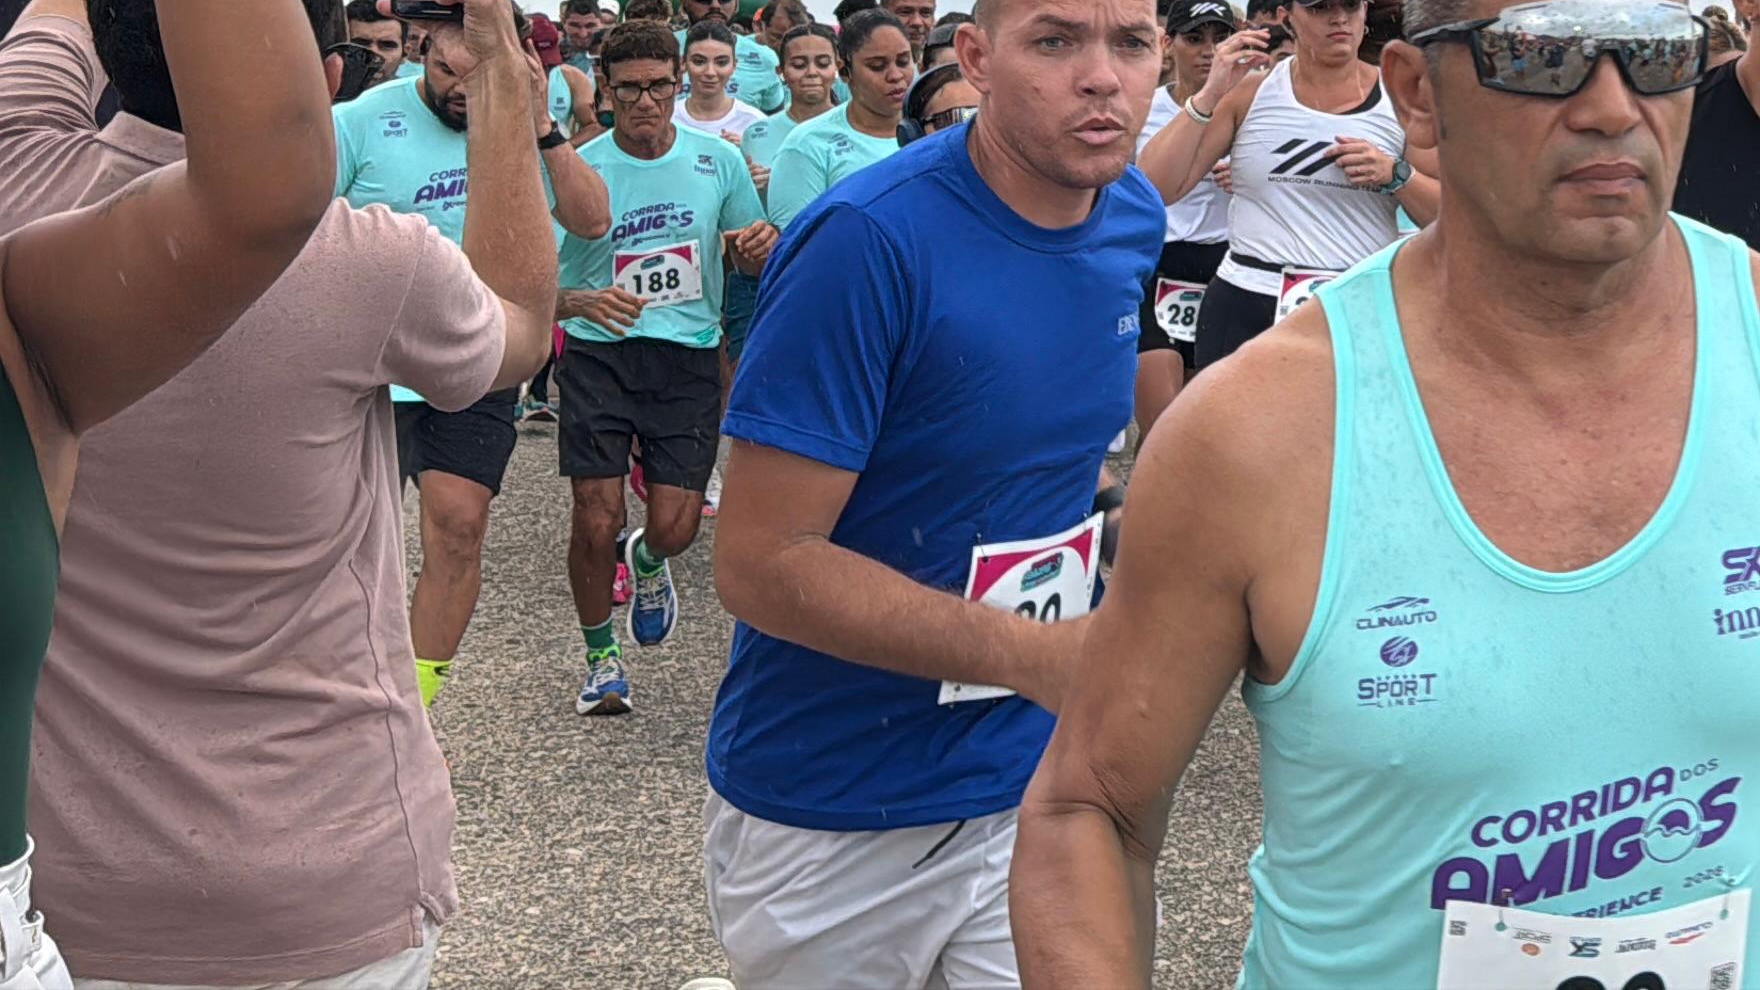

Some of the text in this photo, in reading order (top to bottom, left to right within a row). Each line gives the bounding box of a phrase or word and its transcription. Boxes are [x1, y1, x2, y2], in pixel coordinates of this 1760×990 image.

[429, 167, 467, 183] CORR
[1267, 176, 1312, 185] MOSCOW
[413, 178, 468, 204] AMI
[621, 201, 675, 222] CORRIDA
[611, 209, 695, 243] AMIGOS
[633, 267, 681, 295] 188
[1167, 303, 1196, 327] 28
[1355, 610, 1438, 630] CLINAUTO
[1357, 673, 1438, 700] SPORT
[1470, 758, 1720, 848] CORRIDA DOS
[1430, 776, 1743, 910] AMIGOS
